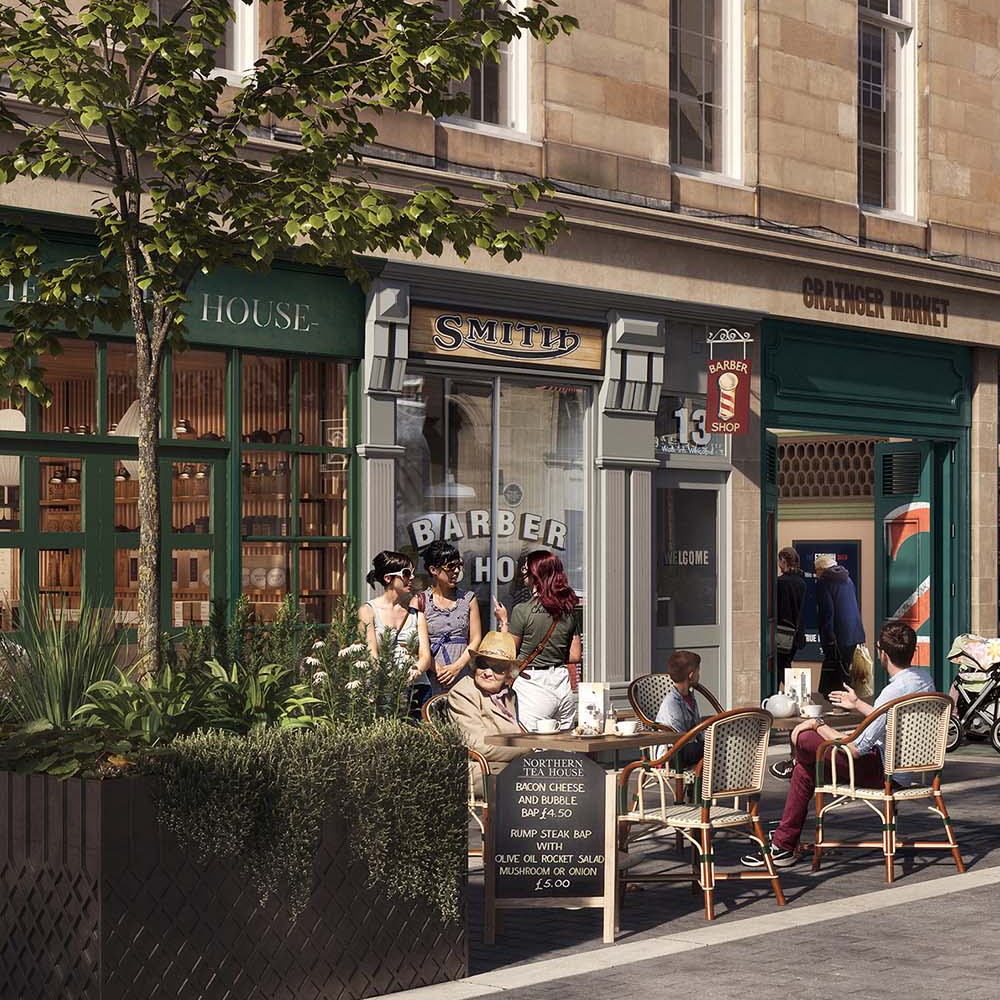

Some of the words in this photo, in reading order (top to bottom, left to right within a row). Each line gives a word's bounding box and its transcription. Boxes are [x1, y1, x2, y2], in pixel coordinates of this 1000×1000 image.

[802, 276, 885, 320] GRAINGER
[890, 290, 950, 329] MARKET
[708, 360, 748, 374] BARBER
[673, 407, 712, 446] 13
[711, 422, 741, 432] SHOP
[408, 510, 568, 550] BARBER
[664, 550, 709, 566] WELCOME
[523, 758, 583, 768] NORTHERN
[523, 767, 544, 777] TEA
[549, 767, 584, 777] HOUSE
[515, 782, 546, 792] BACON
[549, 782, 585, 792] CHEESE
[518, 795, 539, 804] AND
[541, 795, 578, 805] BUBBLE
[521, 808, 539, 817] BAP
[540, 807, 572, 819] £4.50
[510, 829, 538, 838] RUMP
[540, 829, 570, 839] STEAK
[573, 830, 592, 839] BAP
[536, 842, 563, 850] WITH
[495, 854, 520, 863] OLIVE
[523, 854, 538, 863] OIL
[541, 855, 573, 863] ROCKET
[577, 855, 605, 863] SALAD
[499, 866, 550, 876] MUSHROOM
[553, 867, 565, 876] OR
[568, 867, 598, 876] ONION
[534, 878, 571, 891] £5.00
